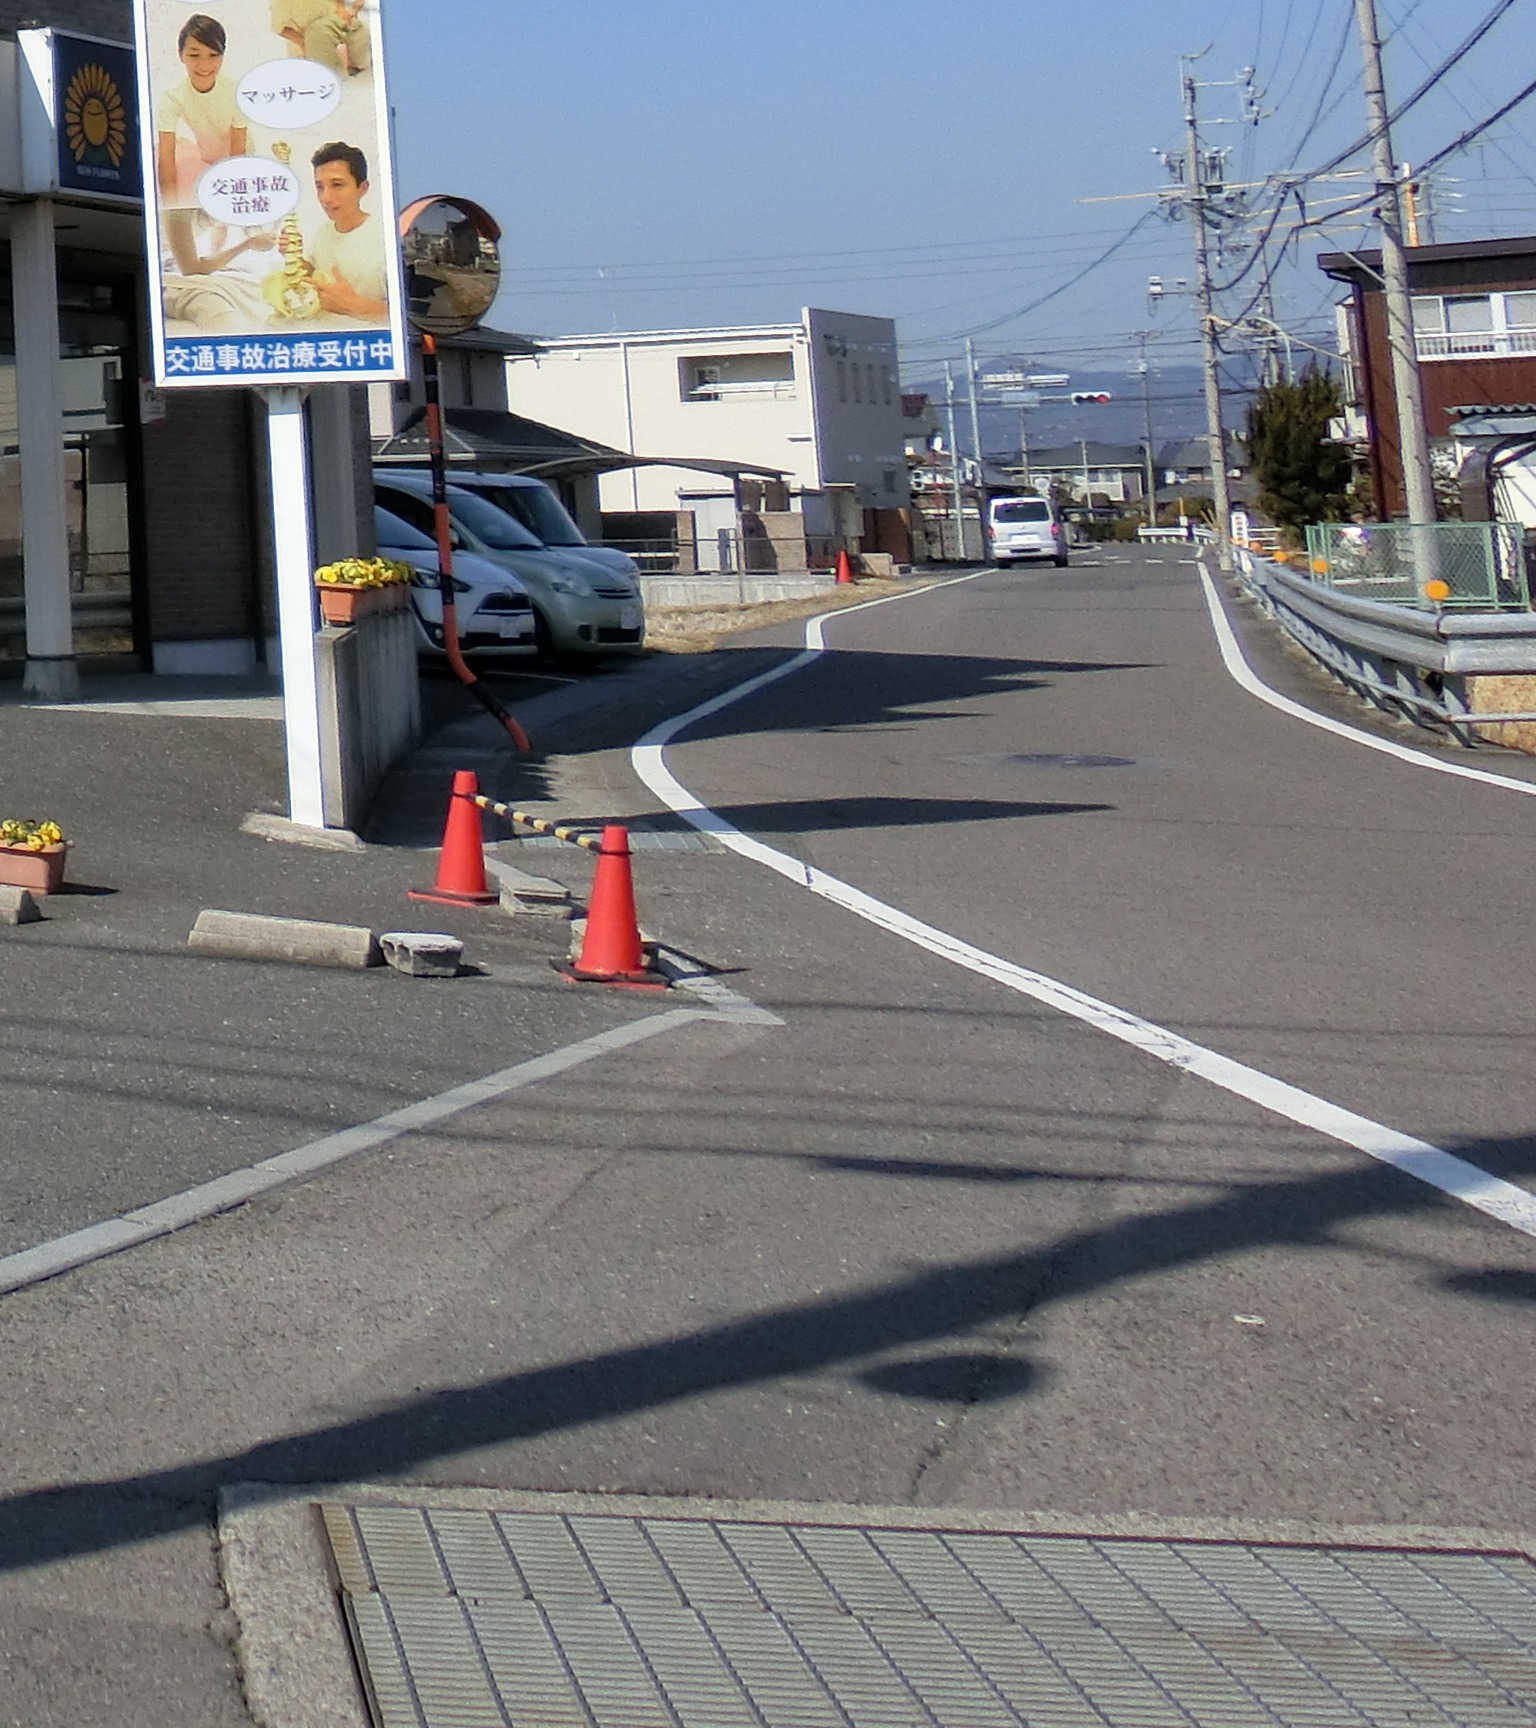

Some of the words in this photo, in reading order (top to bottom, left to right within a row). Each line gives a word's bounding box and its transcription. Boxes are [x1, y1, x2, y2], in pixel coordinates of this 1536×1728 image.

[241, 83, 336, 104] マッサージ
[212, 175, 290, 196] 交通事故
[231, 195, 269, 214] 治療
[166, 338, 392, 373] 交通事故治療受付中
